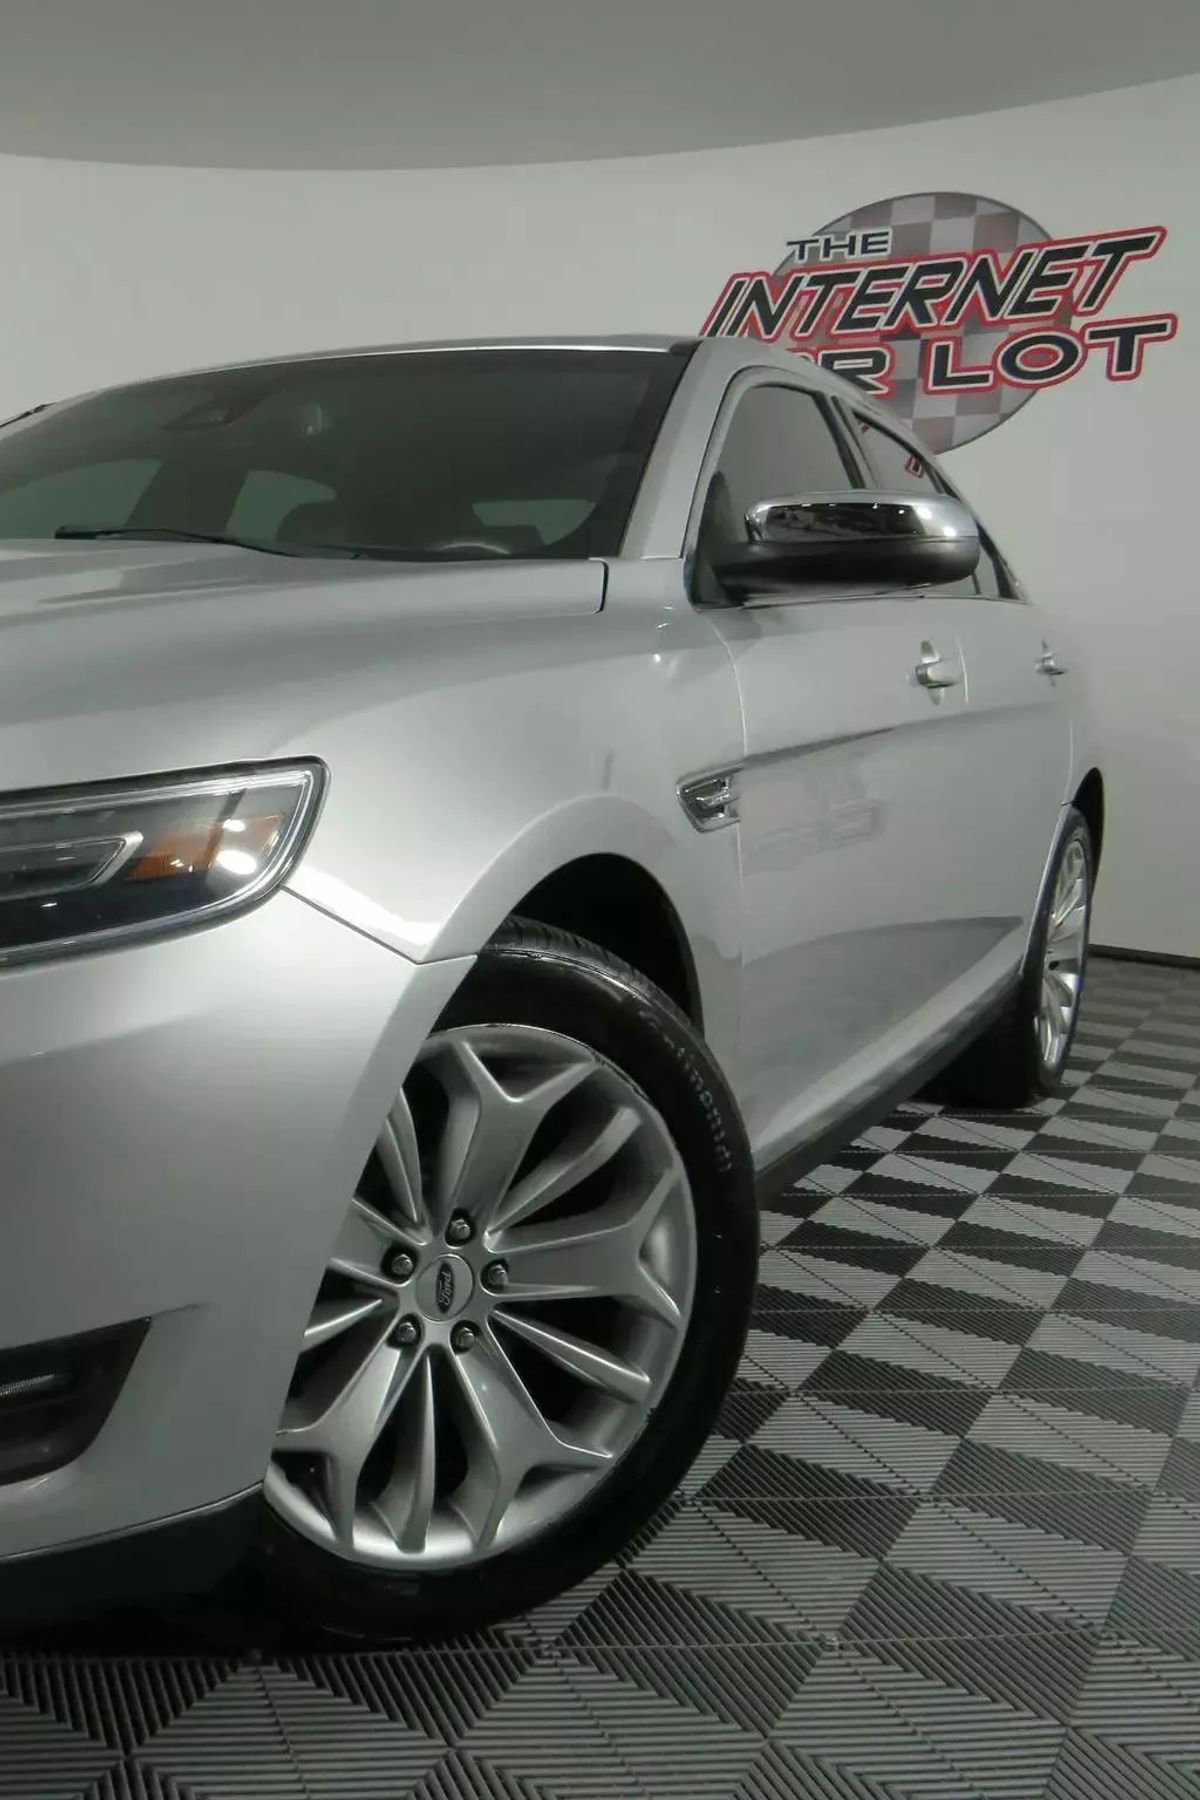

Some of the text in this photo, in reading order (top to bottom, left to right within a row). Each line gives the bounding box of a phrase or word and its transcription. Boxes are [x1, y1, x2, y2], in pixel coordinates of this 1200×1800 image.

[786, 230, 890, 261] THE
[703, 230, 1162, 338] INTERNET
[928, 317, 1172, 390] LOT
